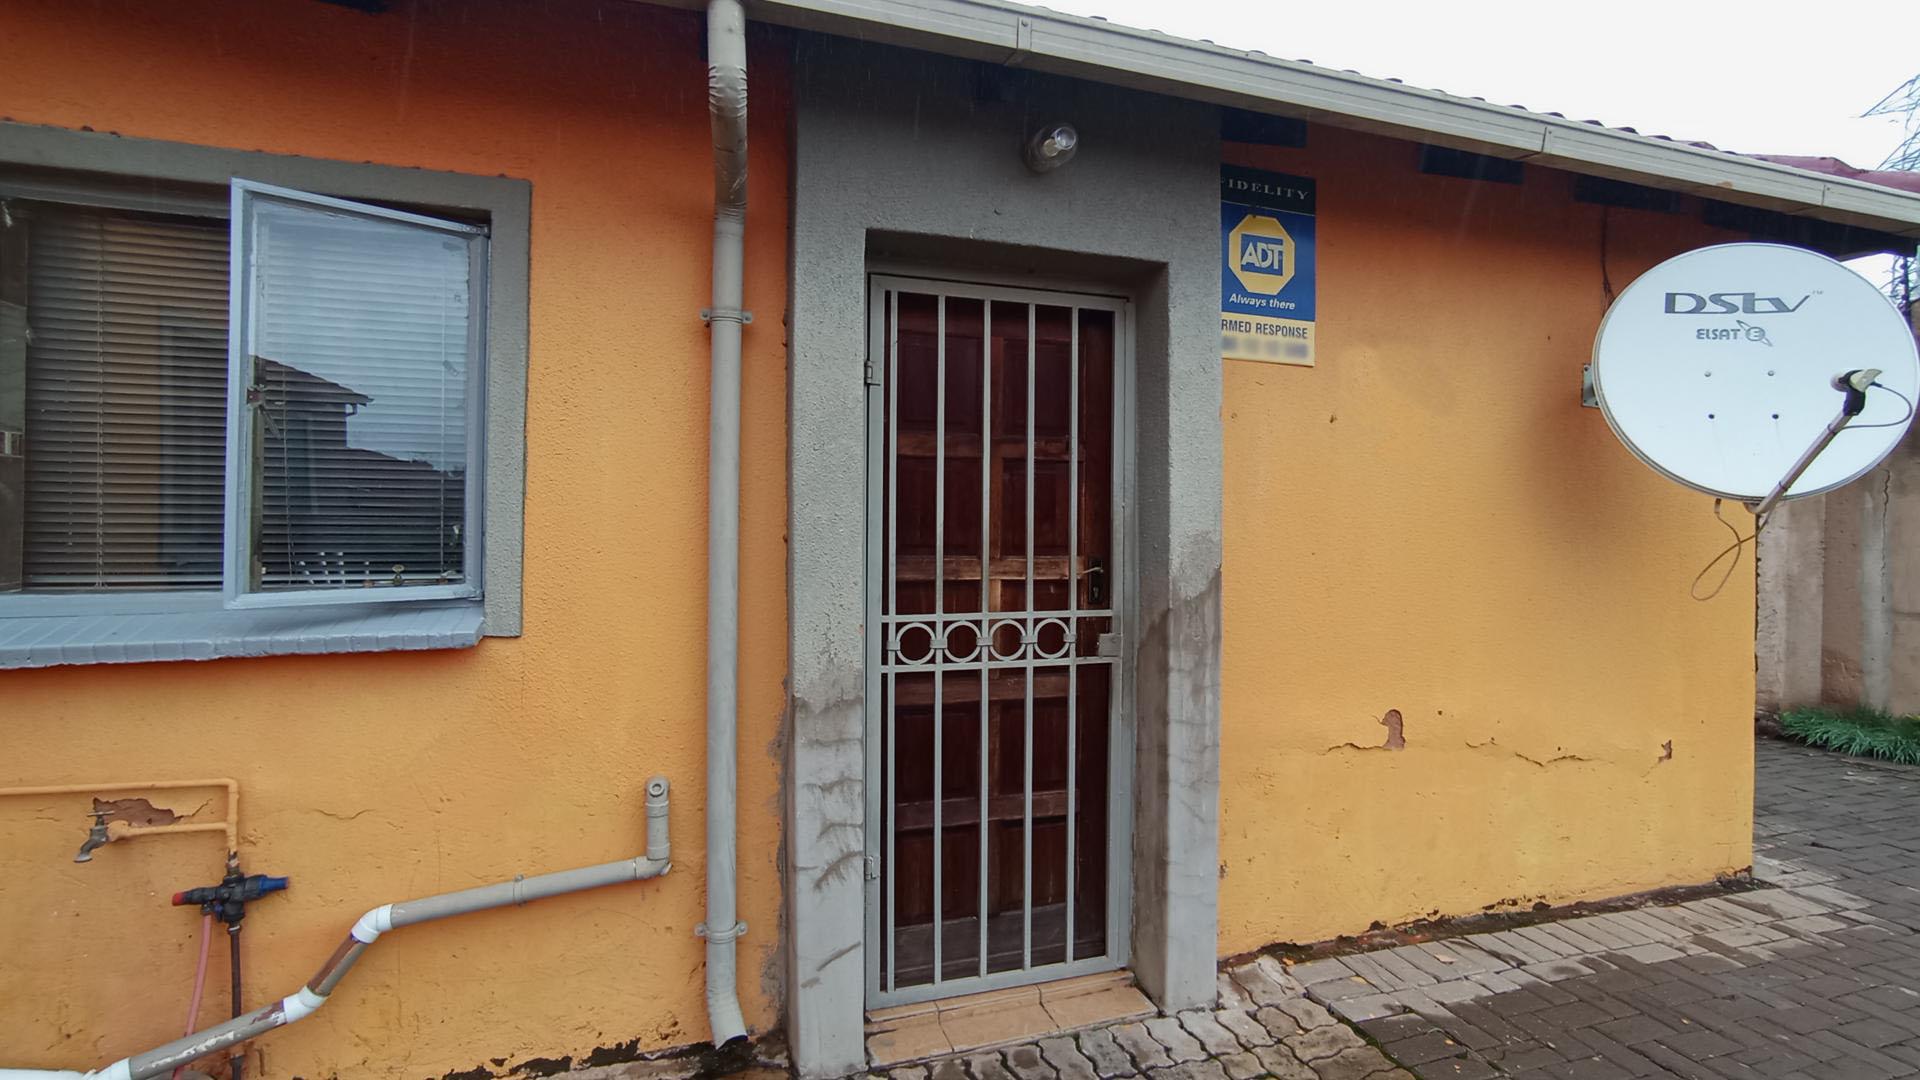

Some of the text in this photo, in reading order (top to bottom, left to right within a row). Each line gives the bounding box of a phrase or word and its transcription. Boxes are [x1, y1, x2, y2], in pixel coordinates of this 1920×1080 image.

[1241, 242, 1284, 270] ADT
[1229, 293, 1296, 310] Always there
[1664, 292, 1810, 314] DStv
[1221, 319, 1308, 340] RMED RESPONSE
[1696, 328, 1741, 340] ELSAT
